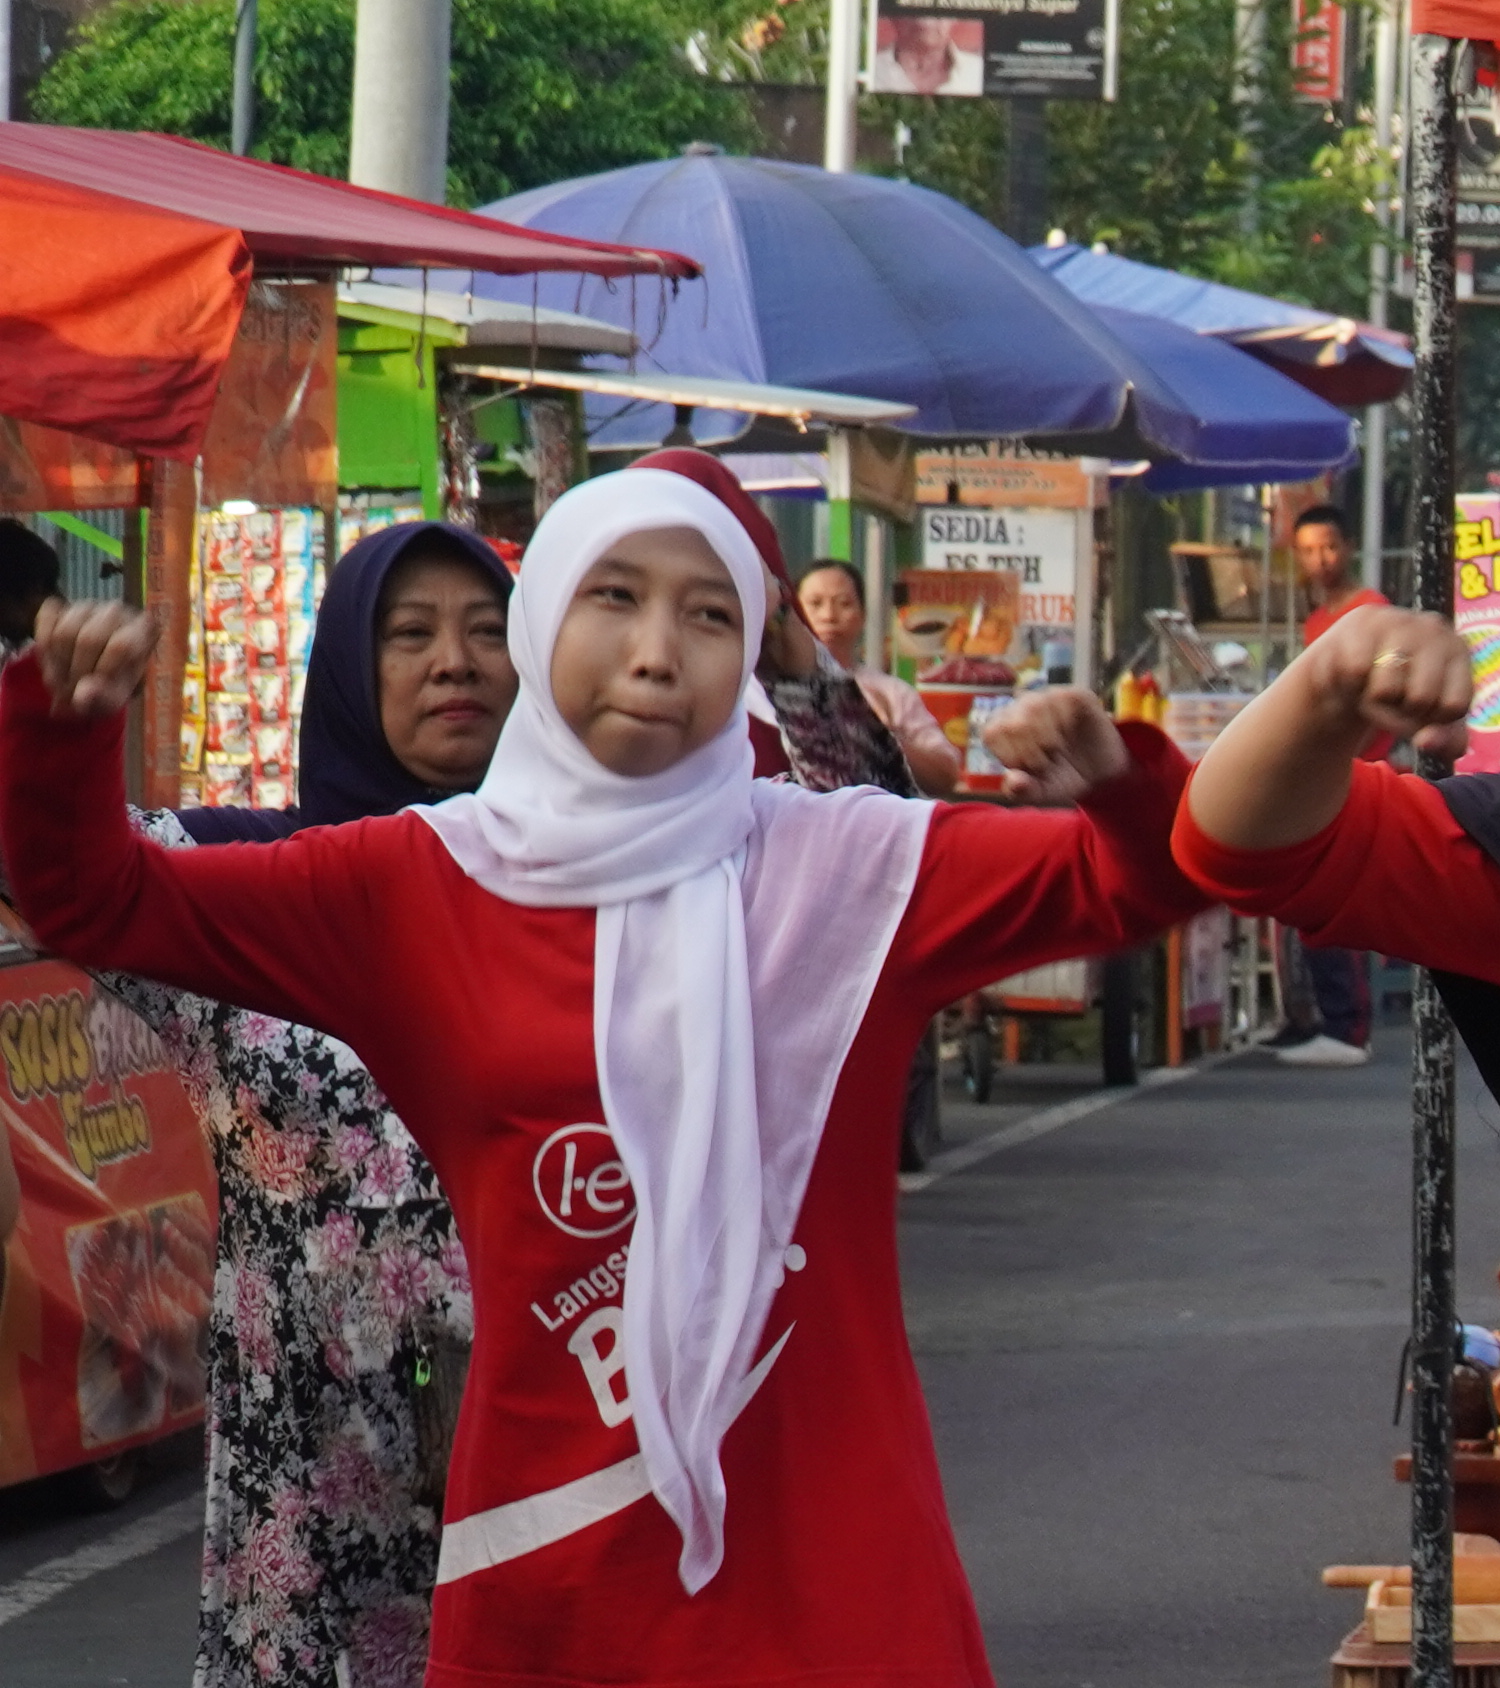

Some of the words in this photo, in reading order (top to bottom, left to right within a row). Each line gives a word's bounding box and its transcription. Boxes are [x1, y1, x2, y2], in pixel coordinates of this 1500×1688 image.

[930, 514, 1009, 544] SEDIA
[1460, 563, 1490, 599] &
[1, 990, 90, 1098] SOSIS
[531, 1245, 630, 1332] Langs
